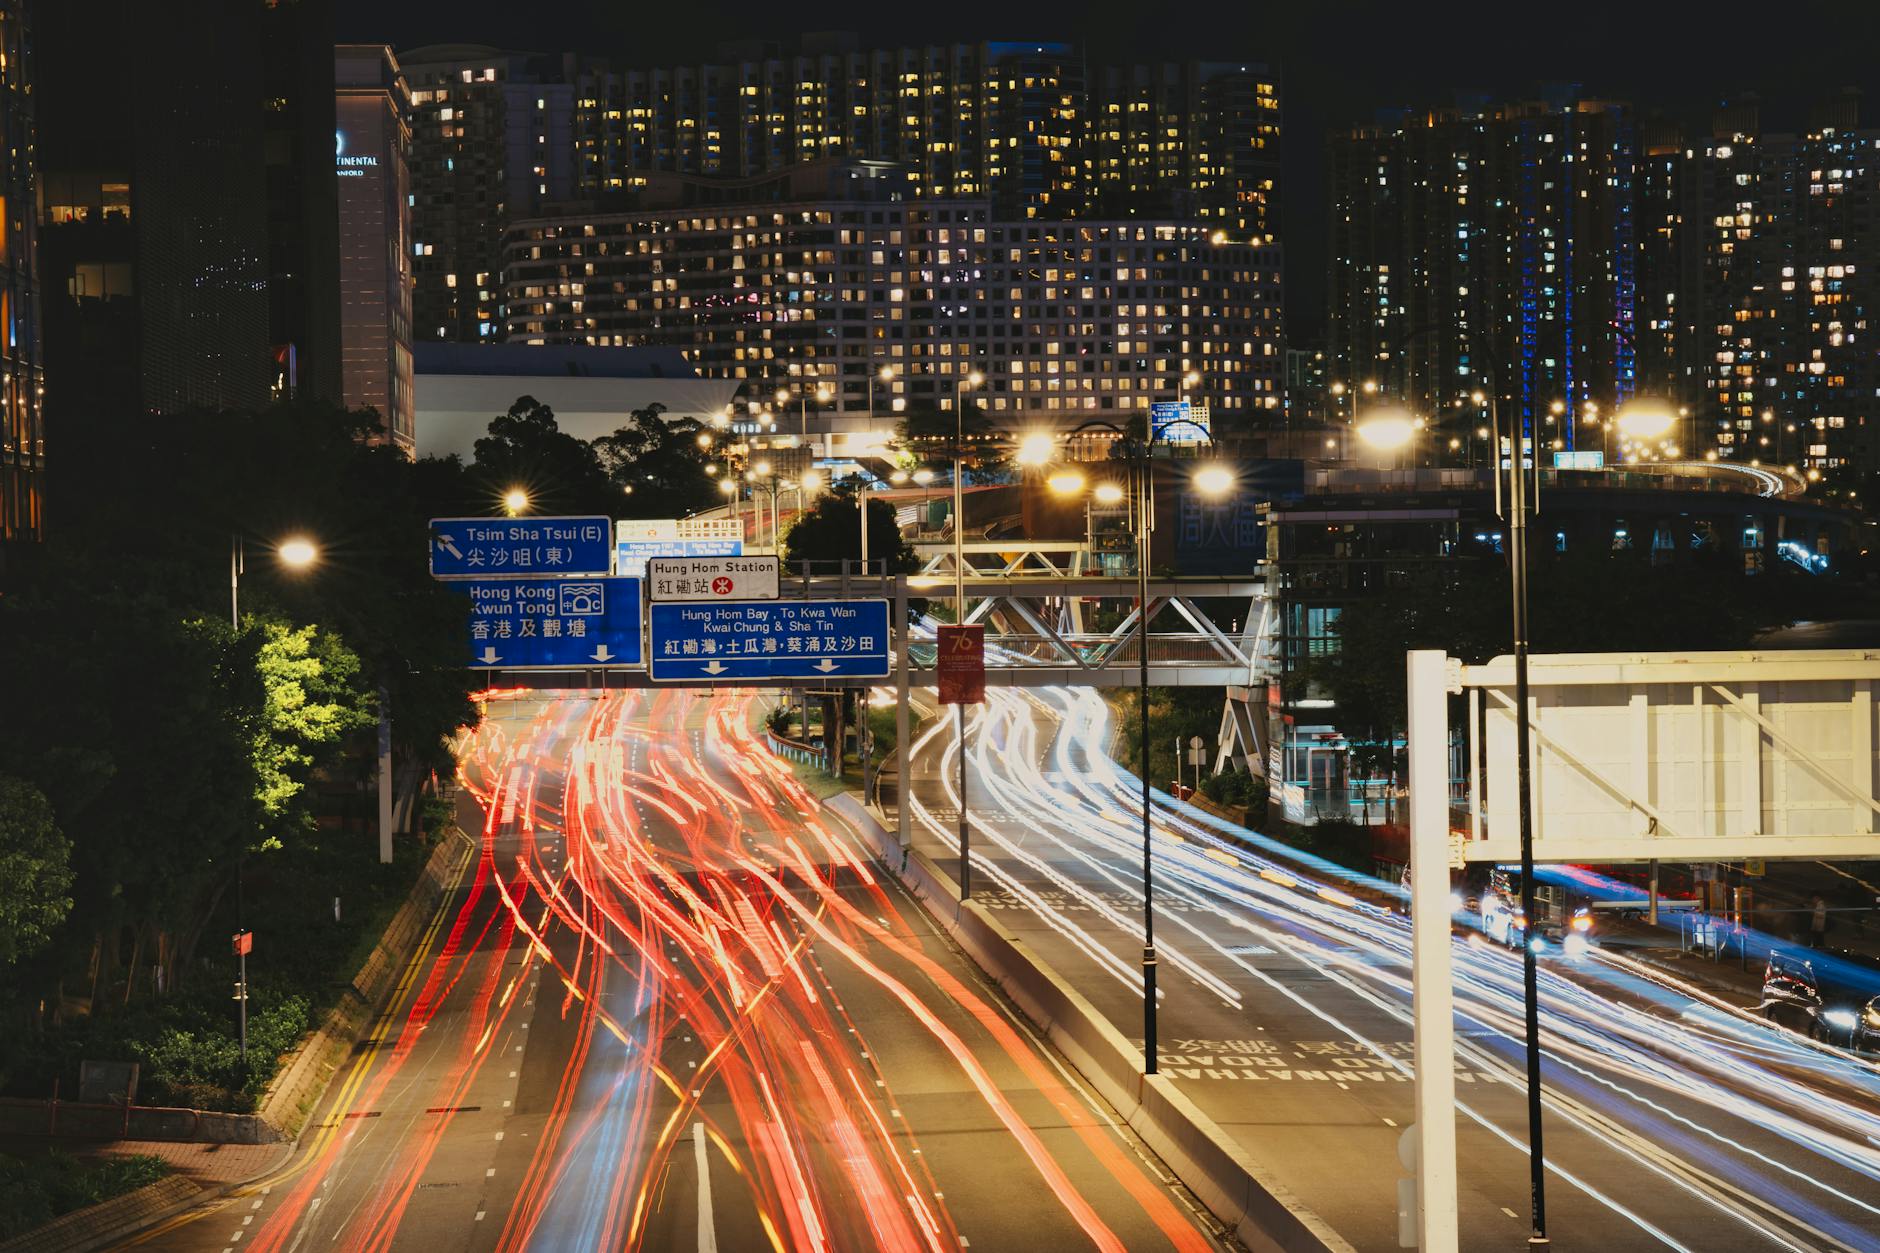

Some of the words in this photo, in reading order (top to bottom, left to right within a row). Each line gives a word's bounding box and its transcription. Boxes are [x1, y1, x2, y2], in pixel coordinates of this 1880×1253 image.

[466, 528, 505, 541] Tsim
[509, 527, 539, 540] Sha
[543, 526, 577, 540] Tsui
[581, 526, 602, 543] (E)
[467, 546, 573, 567] 尖沙咀(東)
[655, 563, 687, 575] Hung
[692, 562, 720, 573] Hom
[725, 562, 774, 573] Station
[470, 586, 510, 601] Hong
[515, 585, 556, 600] Kong
[657, 578, 710, 595] 紅磡站
[470, 602, 513, 615] Kwun
[516, 601, 556, 617] Tong
[682, 609, 712, 622] Hung
[715, 608, 742, 620] Hom
[780, 608, 796, 619] To
[800, 607, 826, 618] Kwa
[831, 606, 857, 618] Wan
[471, 618, 586, 640] 香港及觀塘
[703, 622, 731, 633] Kwai
[733, 621, 770, 634] Chung
[774, 620, 784, 632] &
[789, 620, 812, 632] Sha
[815, 620, 834, 631] Tin
[948, 630, 973, 653] 76
[1324, 1070, 1502, 1084] NAHAN
